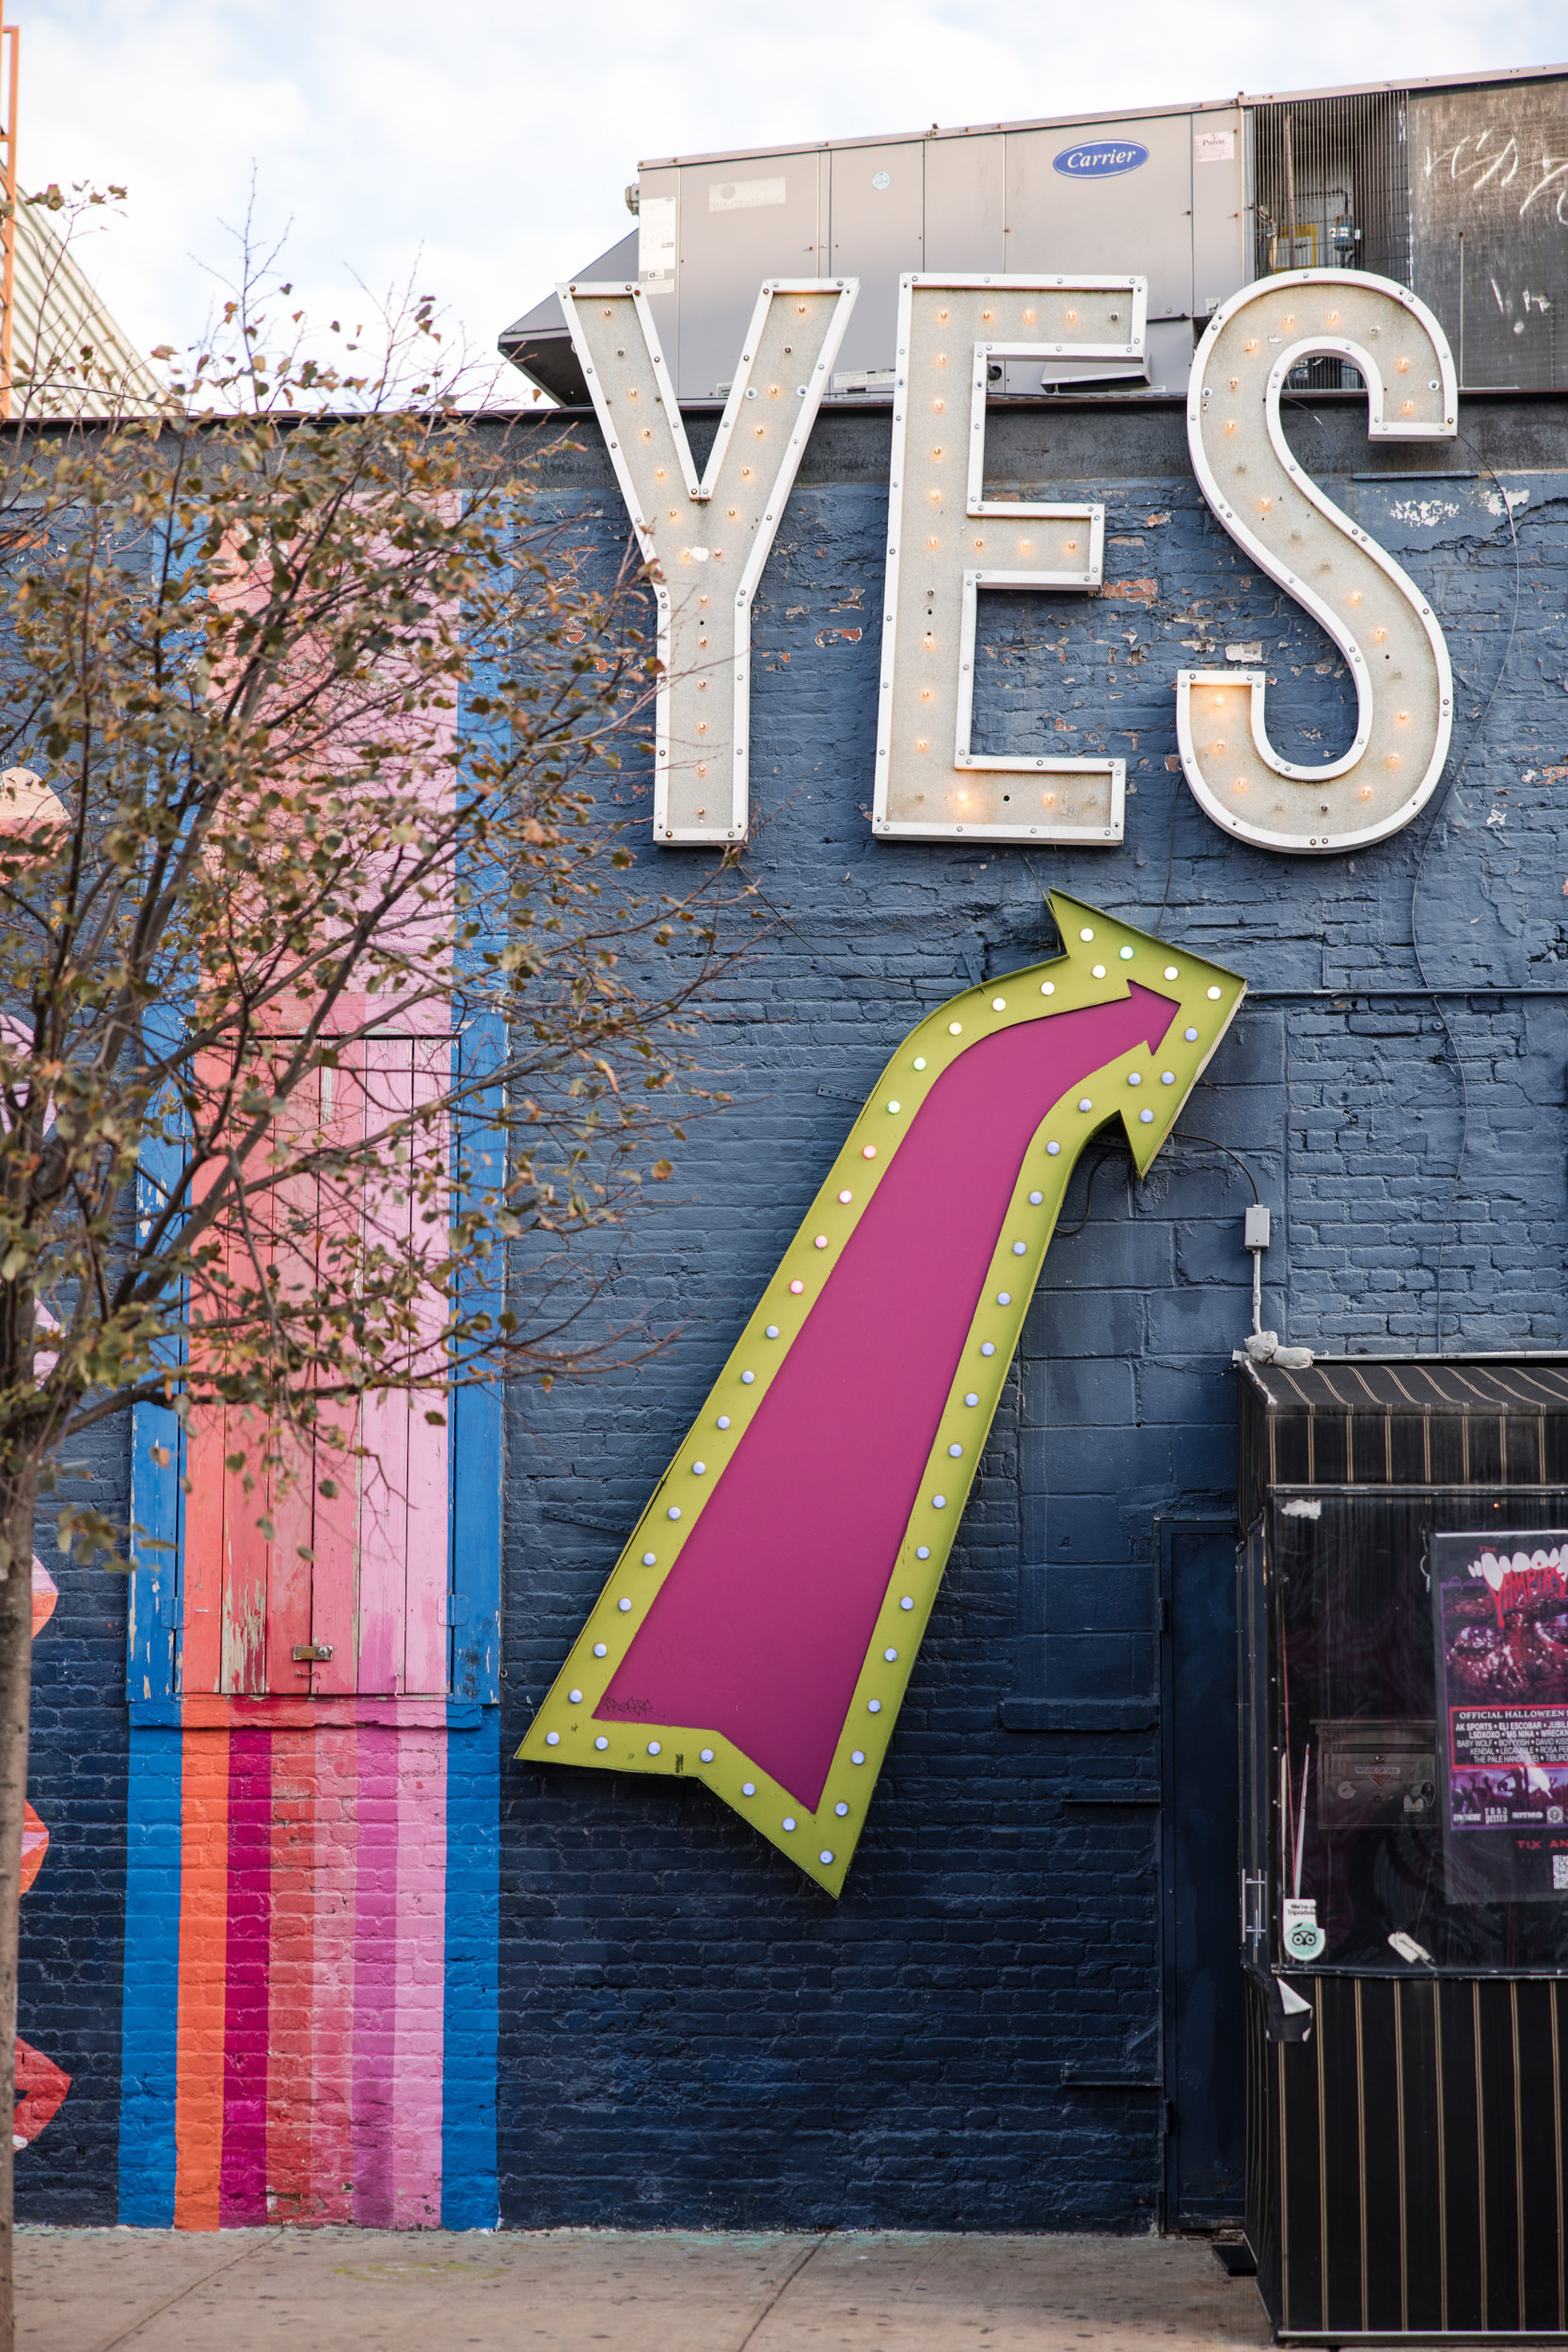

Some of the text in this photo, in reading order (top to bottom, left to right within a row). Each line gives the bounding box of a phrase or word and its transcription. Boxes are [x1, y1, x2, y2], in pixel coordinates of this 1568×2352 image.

[1067, 149, 1136, 168] Carrier
[555, 267, 1460, 855] YES
[1459, 1711, 1503, 1720] OFFICIAL
[1505, 1709, 1564, 1719] HALLOWEEN
[1455, 1723, 1465, 1731] AK
[1465, 1722, 1493, 1731] SPORTS
[1510, 1721, 1542, 1730] ESCOBAR
[1547, 1721, 1568, 1729] JUBIL
[1468, 1730, 1500, 1739] LSDXOXO
[1456, 1740, 1474, 1748] BABY
[1474, 1739, 1493, 1747] WOLF
[1535, 1738, 1554, 1746] DAVID
[1469, 1747, 1495, 1756] KENDAL
[1539, 1745, 1558, 1754] ROSA
[1487, 1755, 1502, 1763] PALE
[1516, 1840, 1542, 1850] TIX
